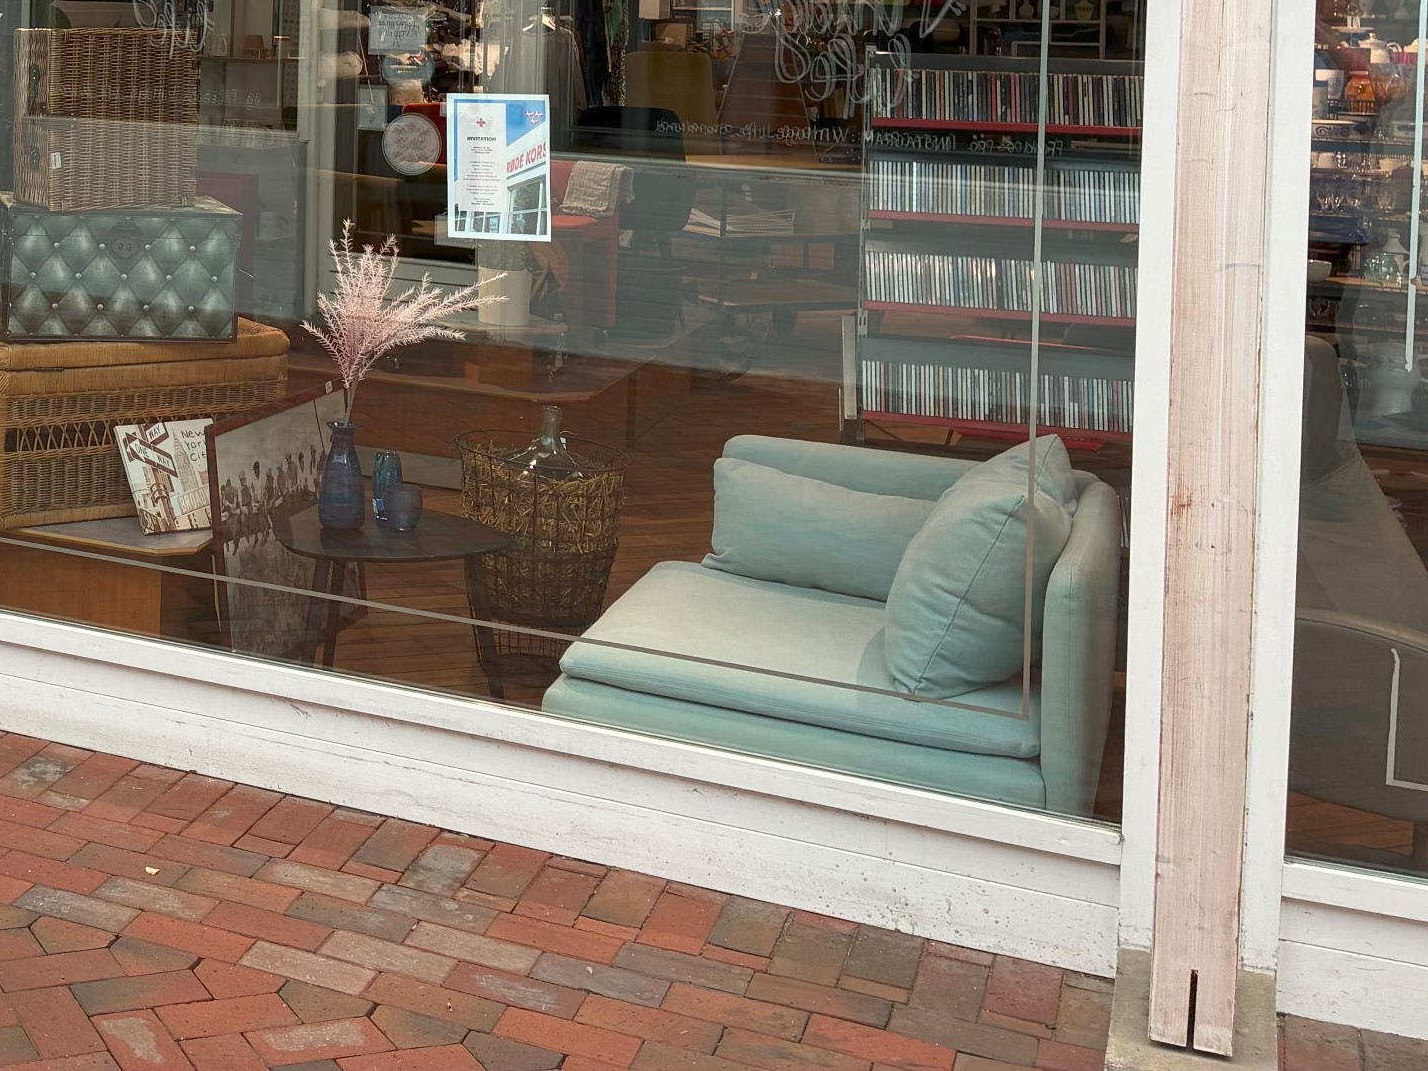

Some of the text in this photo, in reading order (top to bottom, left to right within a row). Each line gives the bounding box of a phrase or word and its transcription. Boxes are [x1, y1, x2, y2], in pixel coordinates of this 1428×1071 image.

[506, 153, 524, 174] RØDE
[147, 424, 162, 440] WAY
[180, 428, 206, 439] New
[185, 440, 207, 451] Yor
[134, 443, 171, 468] ONE WAY
[190, 451, 207, 462] Cit
[180, 490, 210, 514] BROAD
